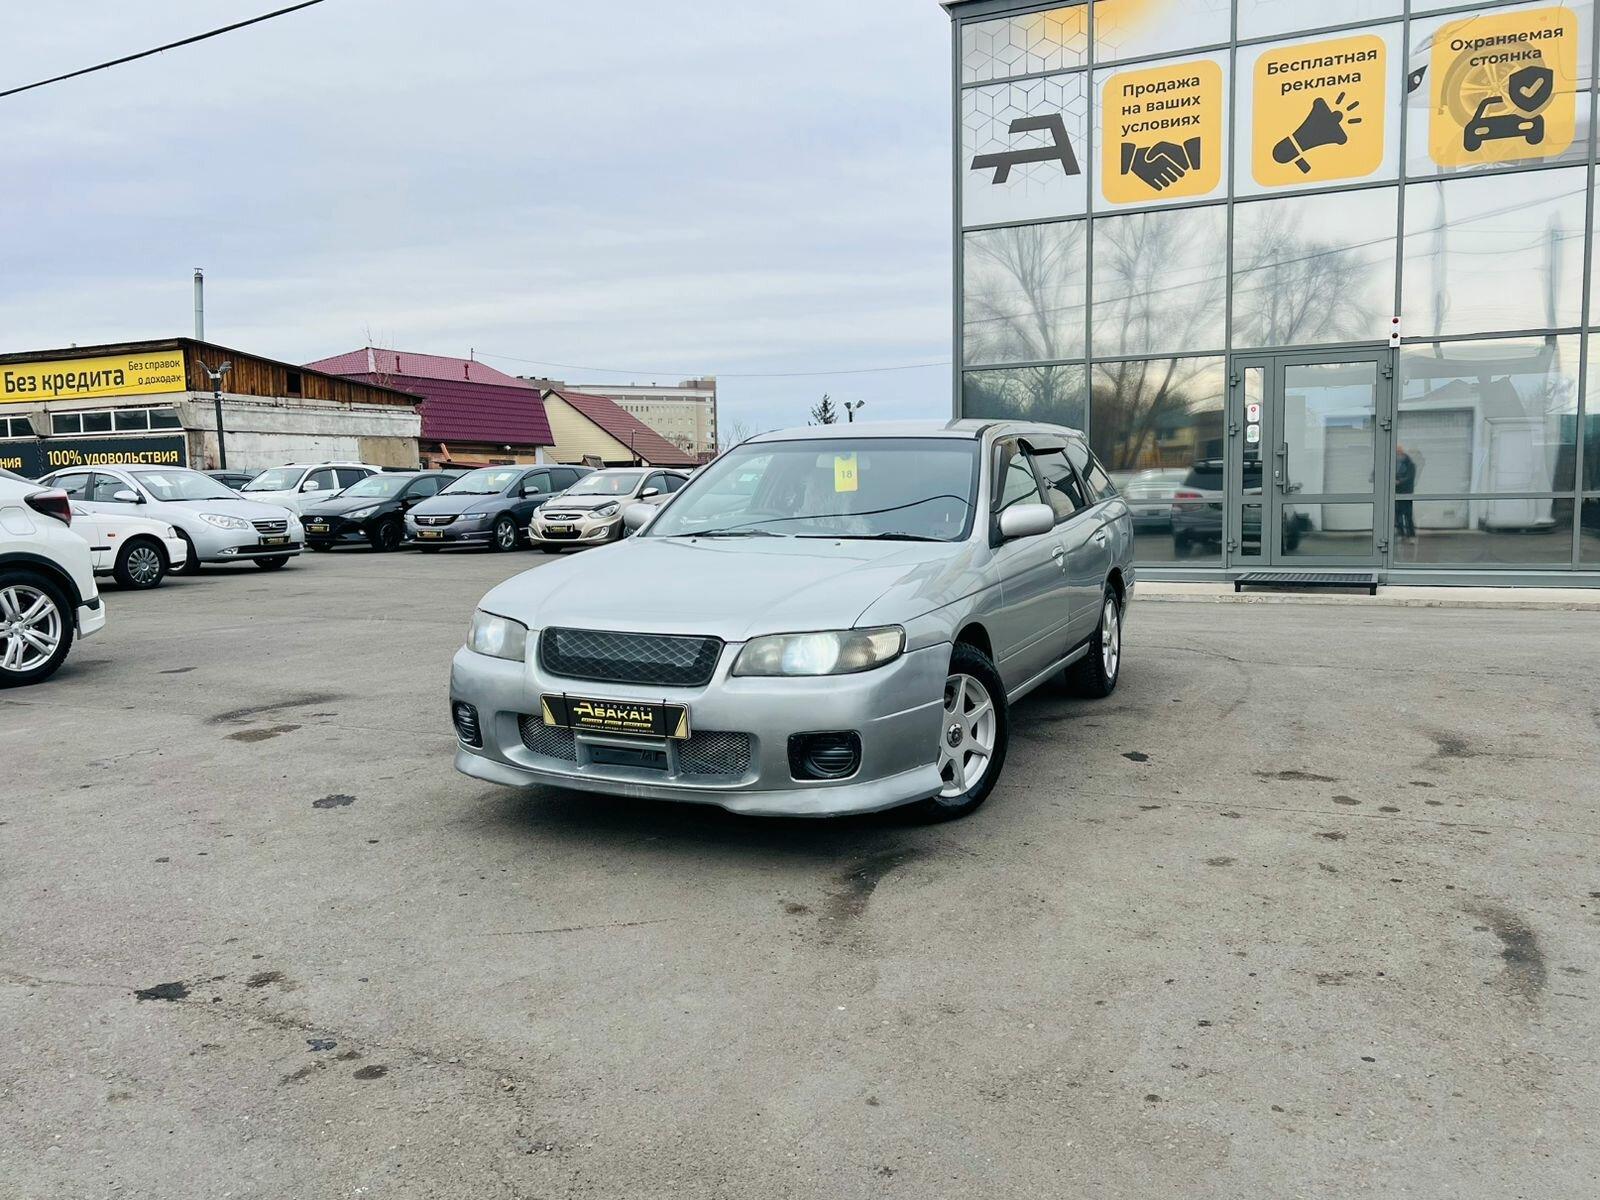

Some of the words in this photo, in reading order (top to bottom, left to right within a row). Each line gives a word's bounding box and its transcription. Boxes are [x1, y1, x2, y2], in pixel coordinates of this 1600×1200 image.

[1450, 28, 1563, 51] Охраняемая
[1267, 50, 1377, 75] Бесплатная
[1470, 49, 1542, 67] стоянка
[1123, 77, 1200, 98] Продажа
[1281, 72, 1361, 95] реклама
[1121, 104, 1141, 115] на
[1146, 96, 1201, 113] ваших
[1121, 114, 1201, 137] условиях
[128, 360, 143, 371] Без
[145, 360, 181, 371] справок
[4, 371, 37, 393] Без
[42, 368, 125, 396] кредита
[138, 377, 143, 385] о
[145, 375, 182, 385] доходах
[47, 450, 82, 466] 100%
[84, 451, 178, 466] удовольствия
[841, 470, 853, 479] 18
